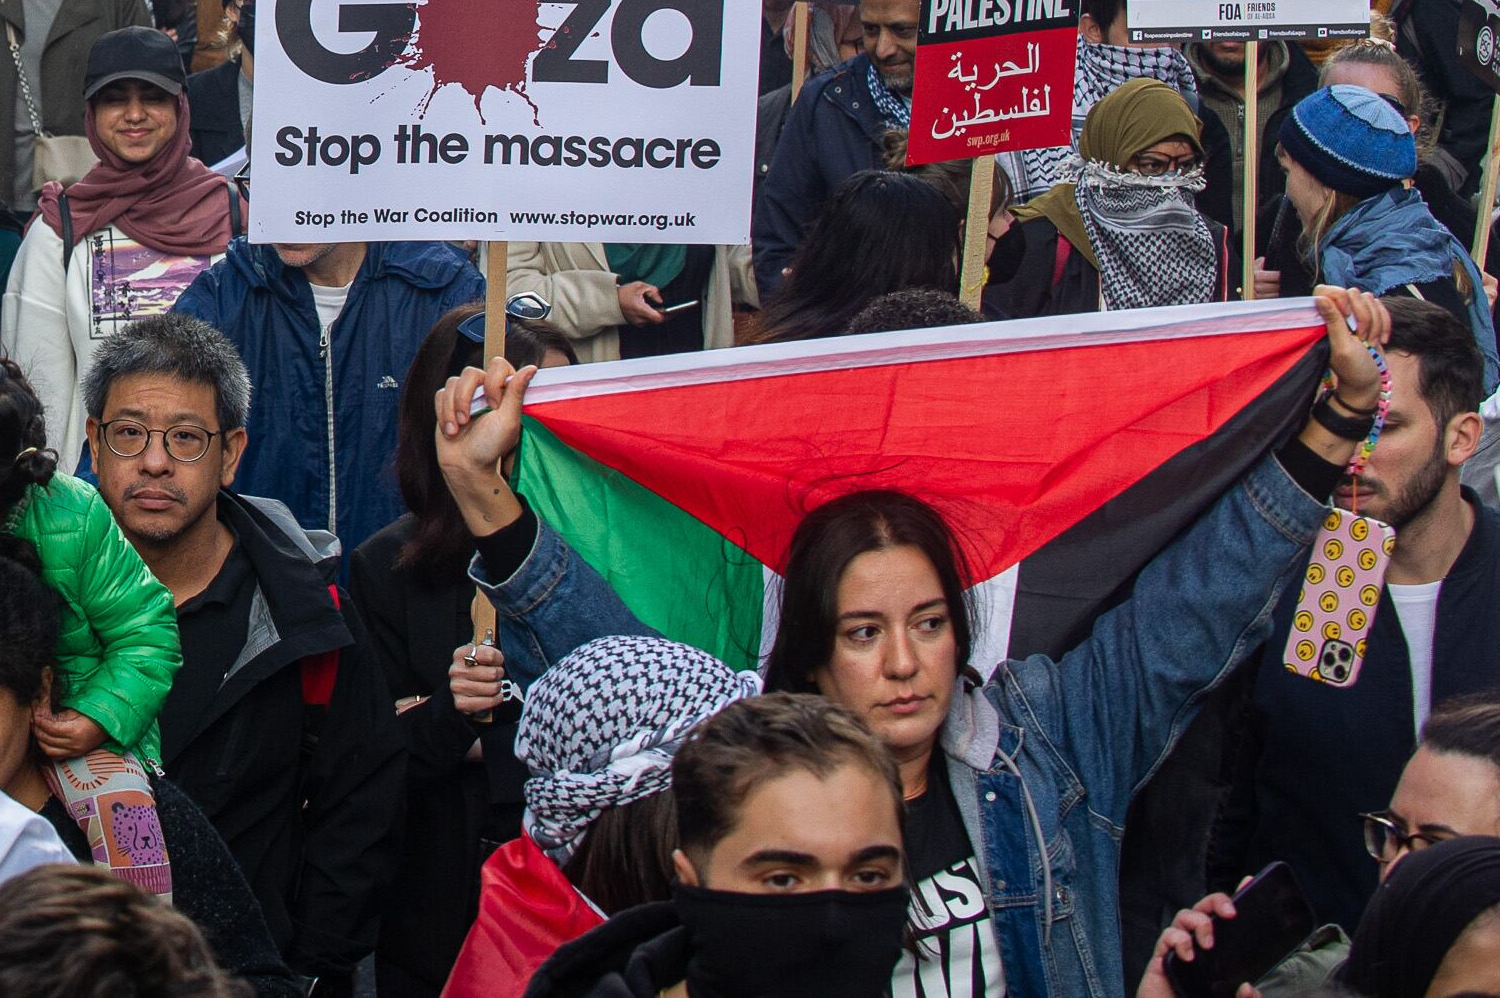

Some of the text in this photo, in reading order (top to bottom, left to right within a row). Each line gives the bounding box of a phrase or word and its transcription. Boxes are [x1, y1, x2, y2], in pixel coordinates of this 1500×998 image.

[1219, 2, 1276, 21] FOA FRIENDS
[947, 42, 1041, 92] الحرية
[931, 84, 1051, 139] لفلسطين
[275, 123, 721, 175] Stop the massacre
[967, 129, 1010, 147] swp.org.uk
[295, 207, 696, 229] Stop the War Coalition www.stopwar.org.uk
